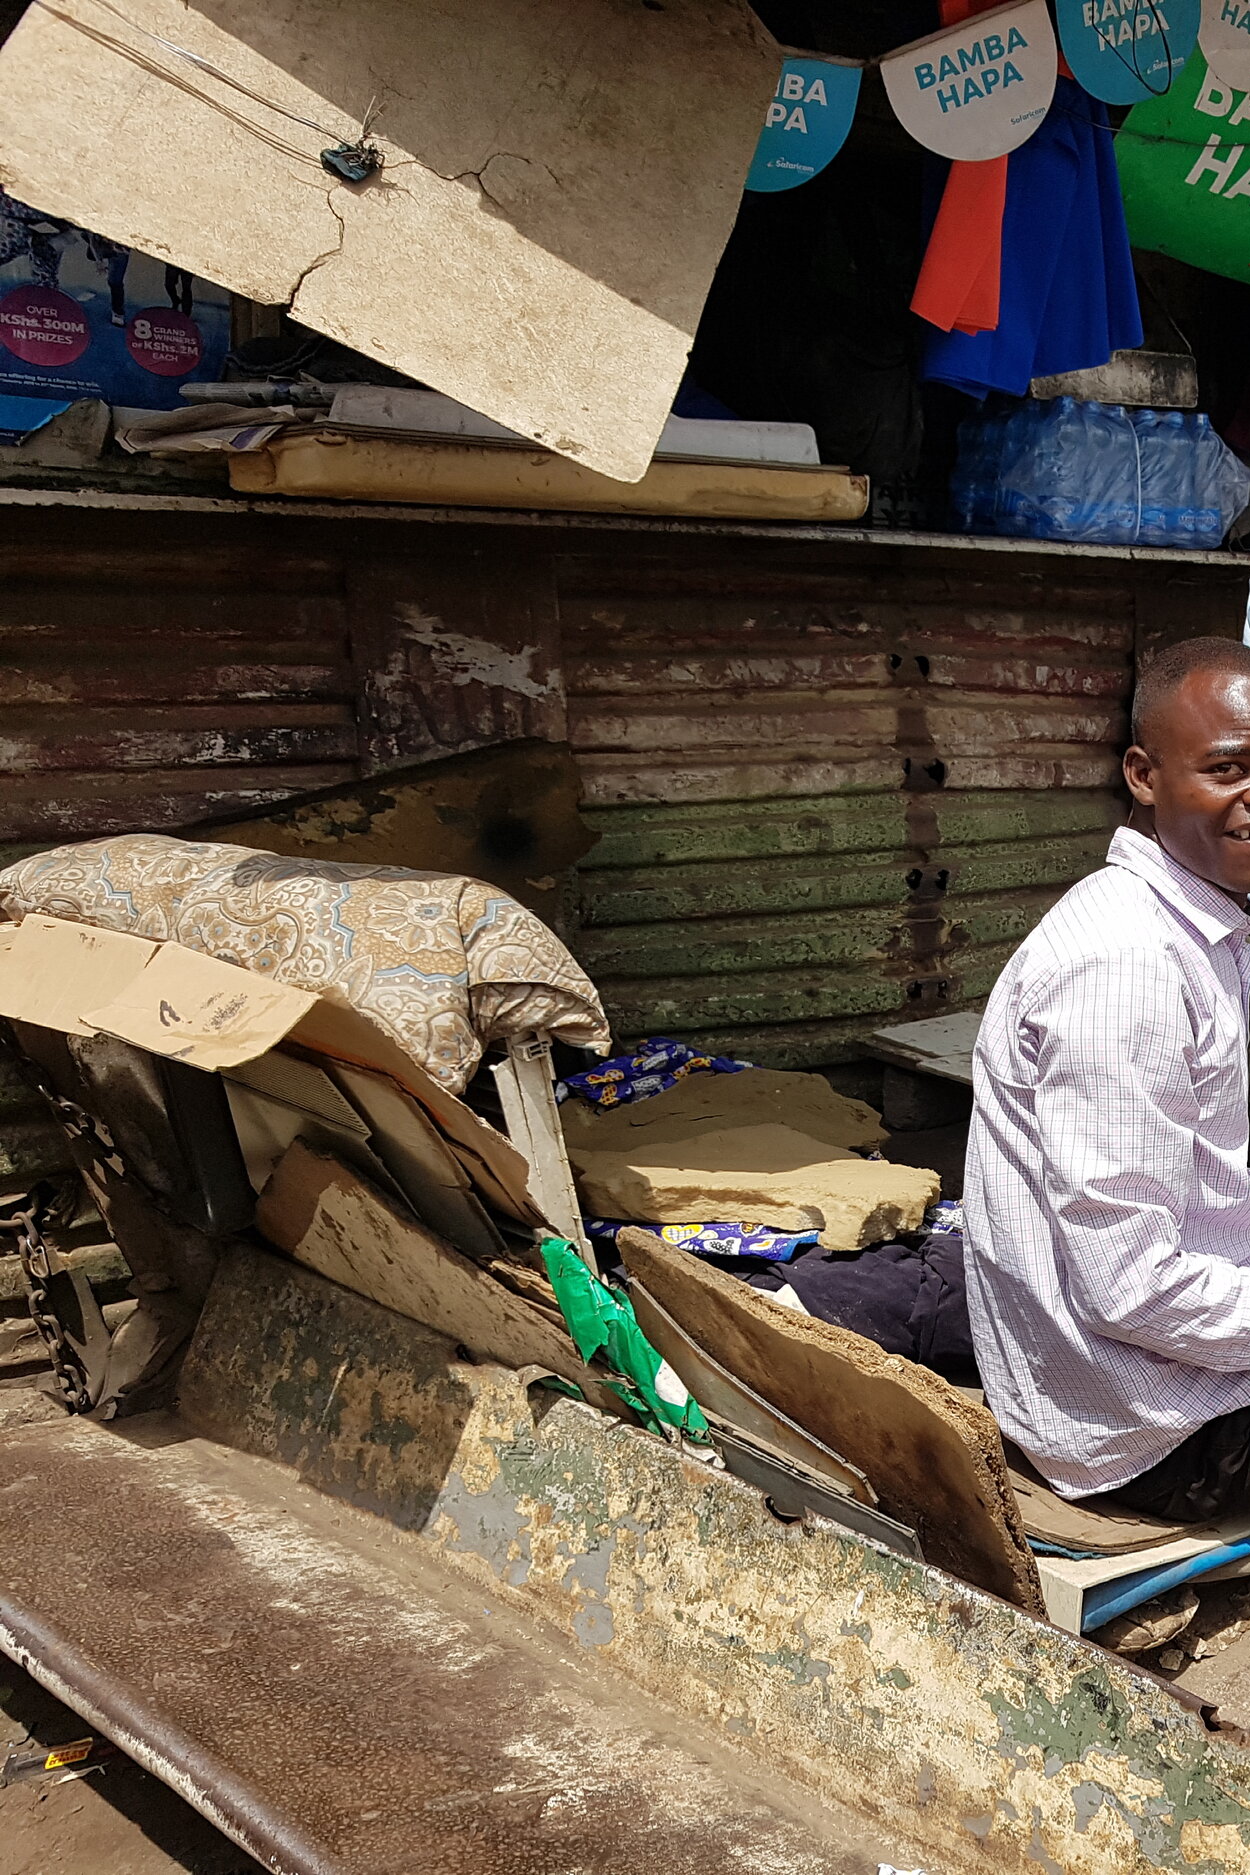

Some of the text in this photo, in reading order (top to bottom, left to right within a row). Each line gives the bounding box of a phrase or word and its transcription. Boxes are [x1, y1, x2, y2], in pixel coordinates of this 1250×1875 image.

[1098, 9, 1170, 52] HAPA
[913, 26, 1029, 91] BAMBA
[936, 60, 1025, 114] HAPA
[775, 159, 815, 173] Safaricom
[26, 305, 58, 318] OVER
[43, 317, 85, 334] 300M
[134, 318, 187, 340] 8 GRAND
[12, 328, 74, 345] IN PRIZES
[153, 333, 197, 346] WINNERS
[152, 352, 179, 363] EACH
[179, 344, 199, 356] 2M
